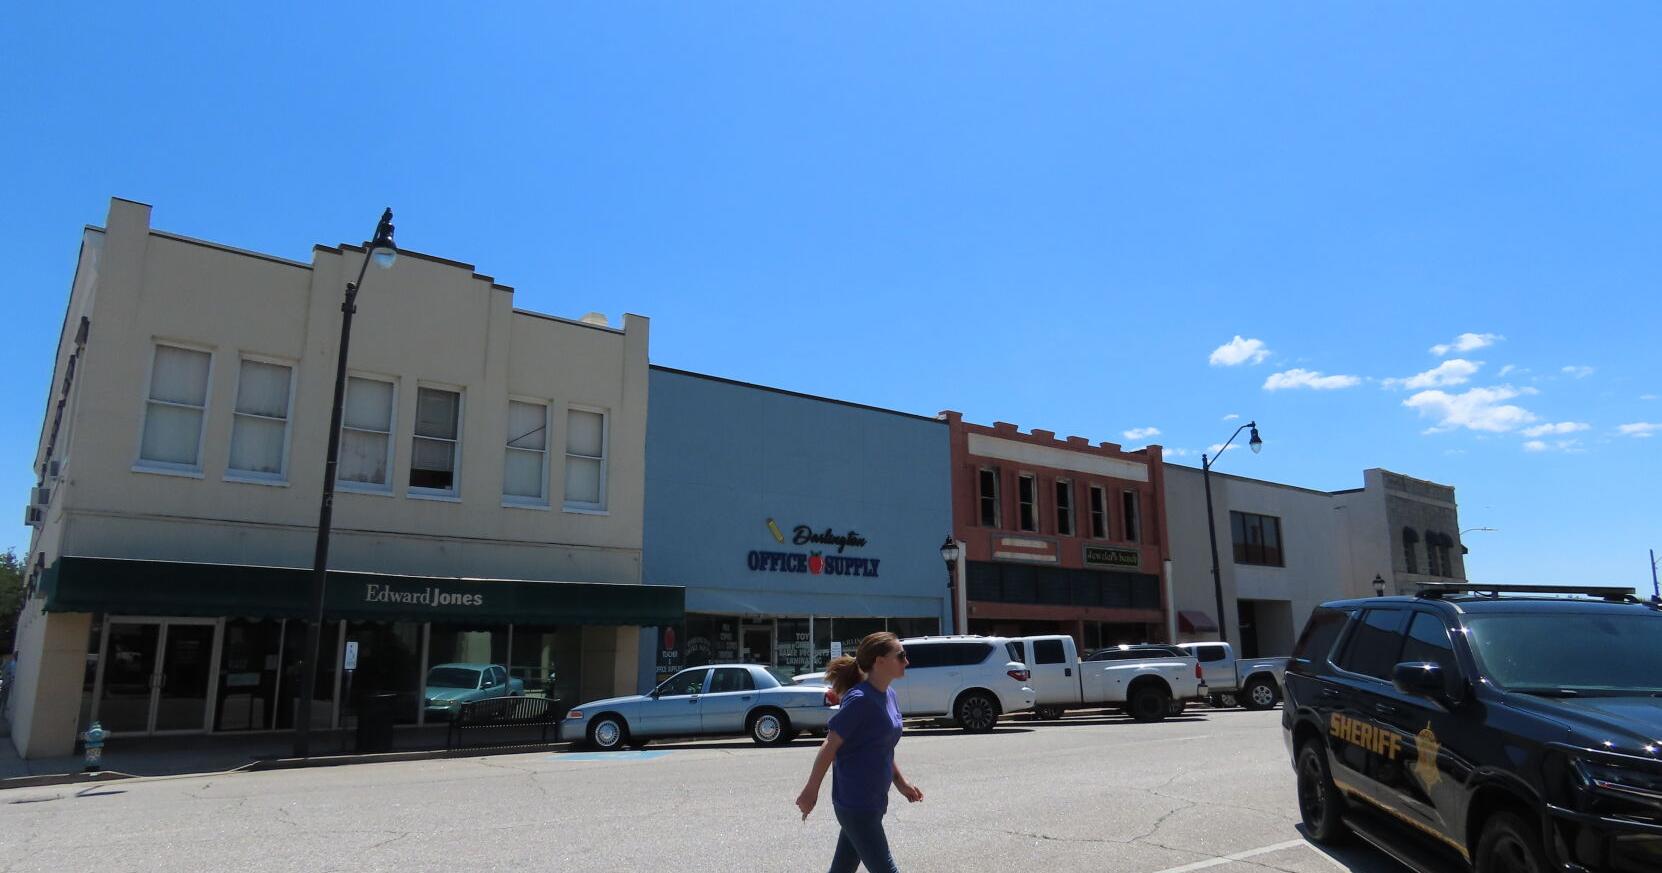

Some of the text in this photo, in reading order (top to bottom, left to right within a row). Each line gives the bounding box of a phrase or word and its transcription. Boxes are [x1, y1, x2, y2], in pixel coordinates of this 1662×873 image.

[793, 525, 868, 553] Darlington
[748, 550, 880, 577] OFFICE SUPPLY
[366, 584, 483, 606] Edward Jones
[1330, 712, 1402, 760] SHERIFF
